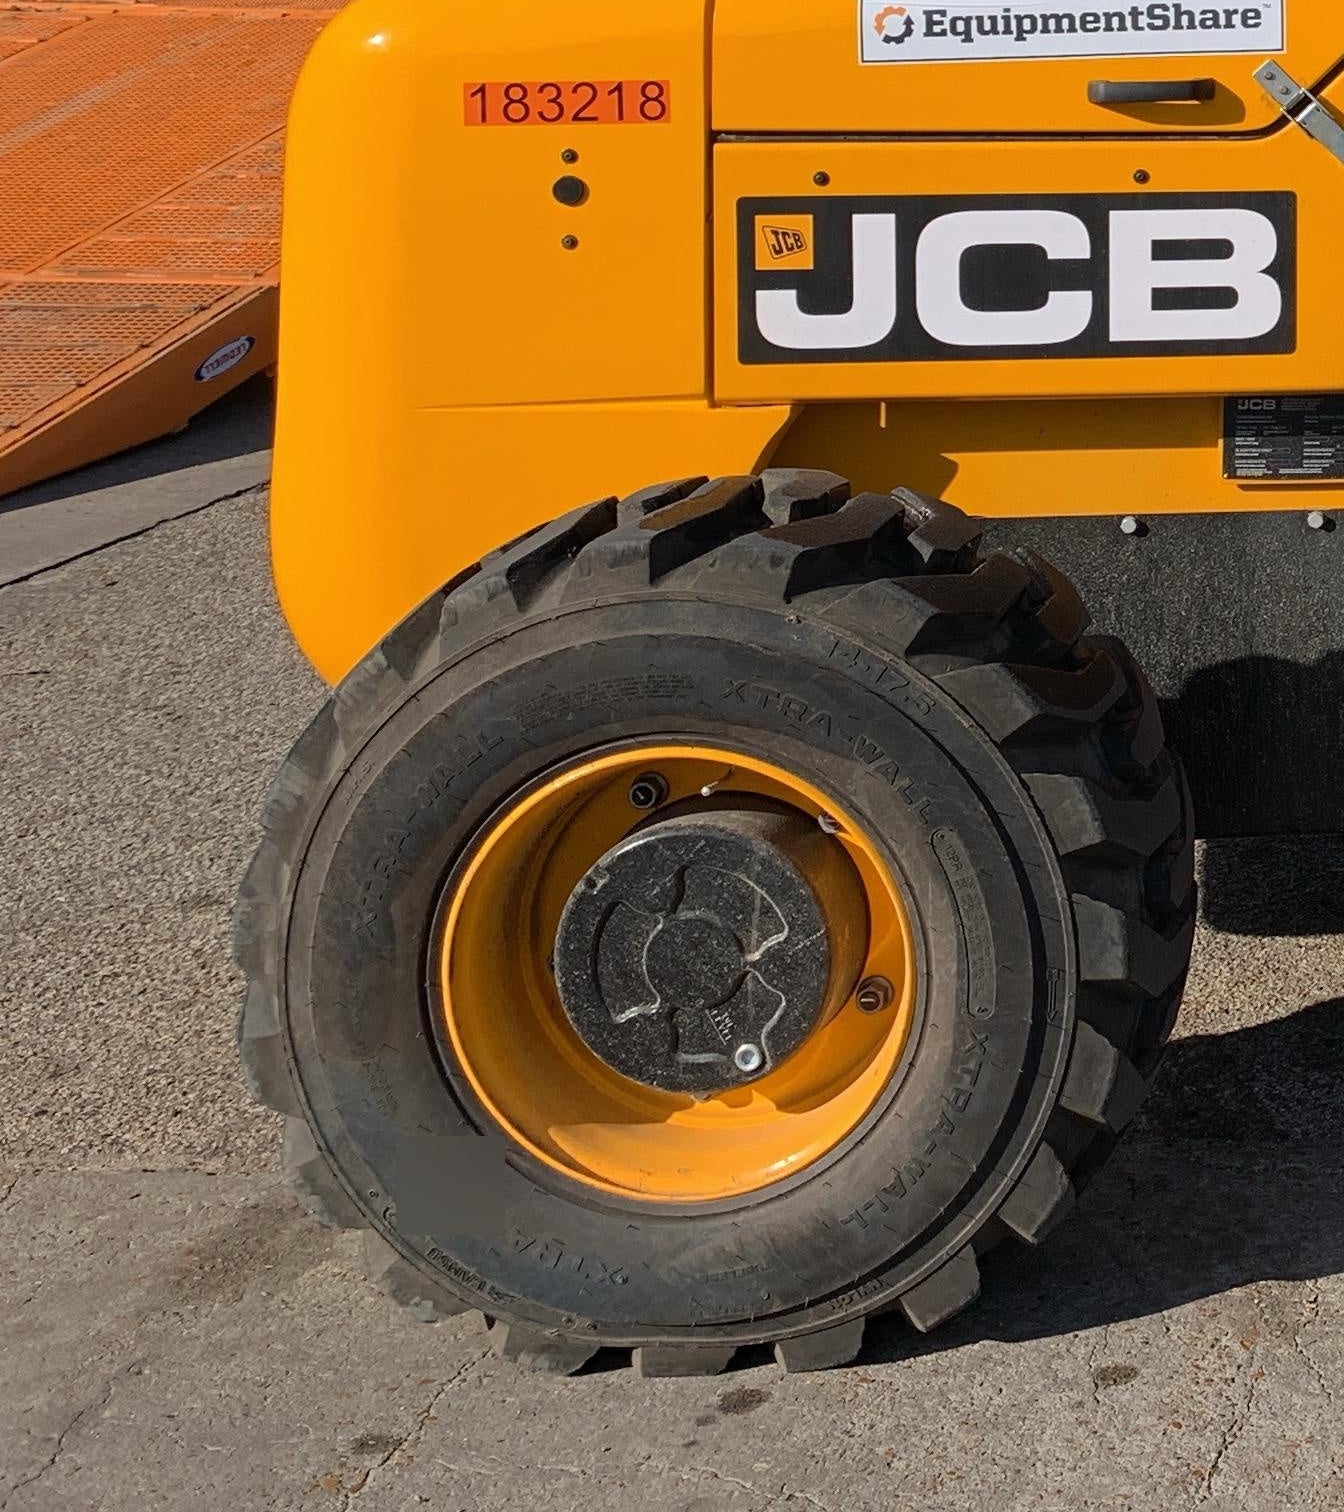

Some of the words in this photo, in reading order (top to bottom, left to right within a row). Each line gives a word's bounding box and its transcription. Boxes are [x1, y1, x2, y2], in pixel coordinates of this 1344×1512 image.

[922, 2, 1263, 43] EquipmentShare
[469, 80, 667, 124] 183218
[770, 228, 804, 256] JCB
[755, 208, 1283, 349] JCB
[1237, 399, 1277, 410] JCB
